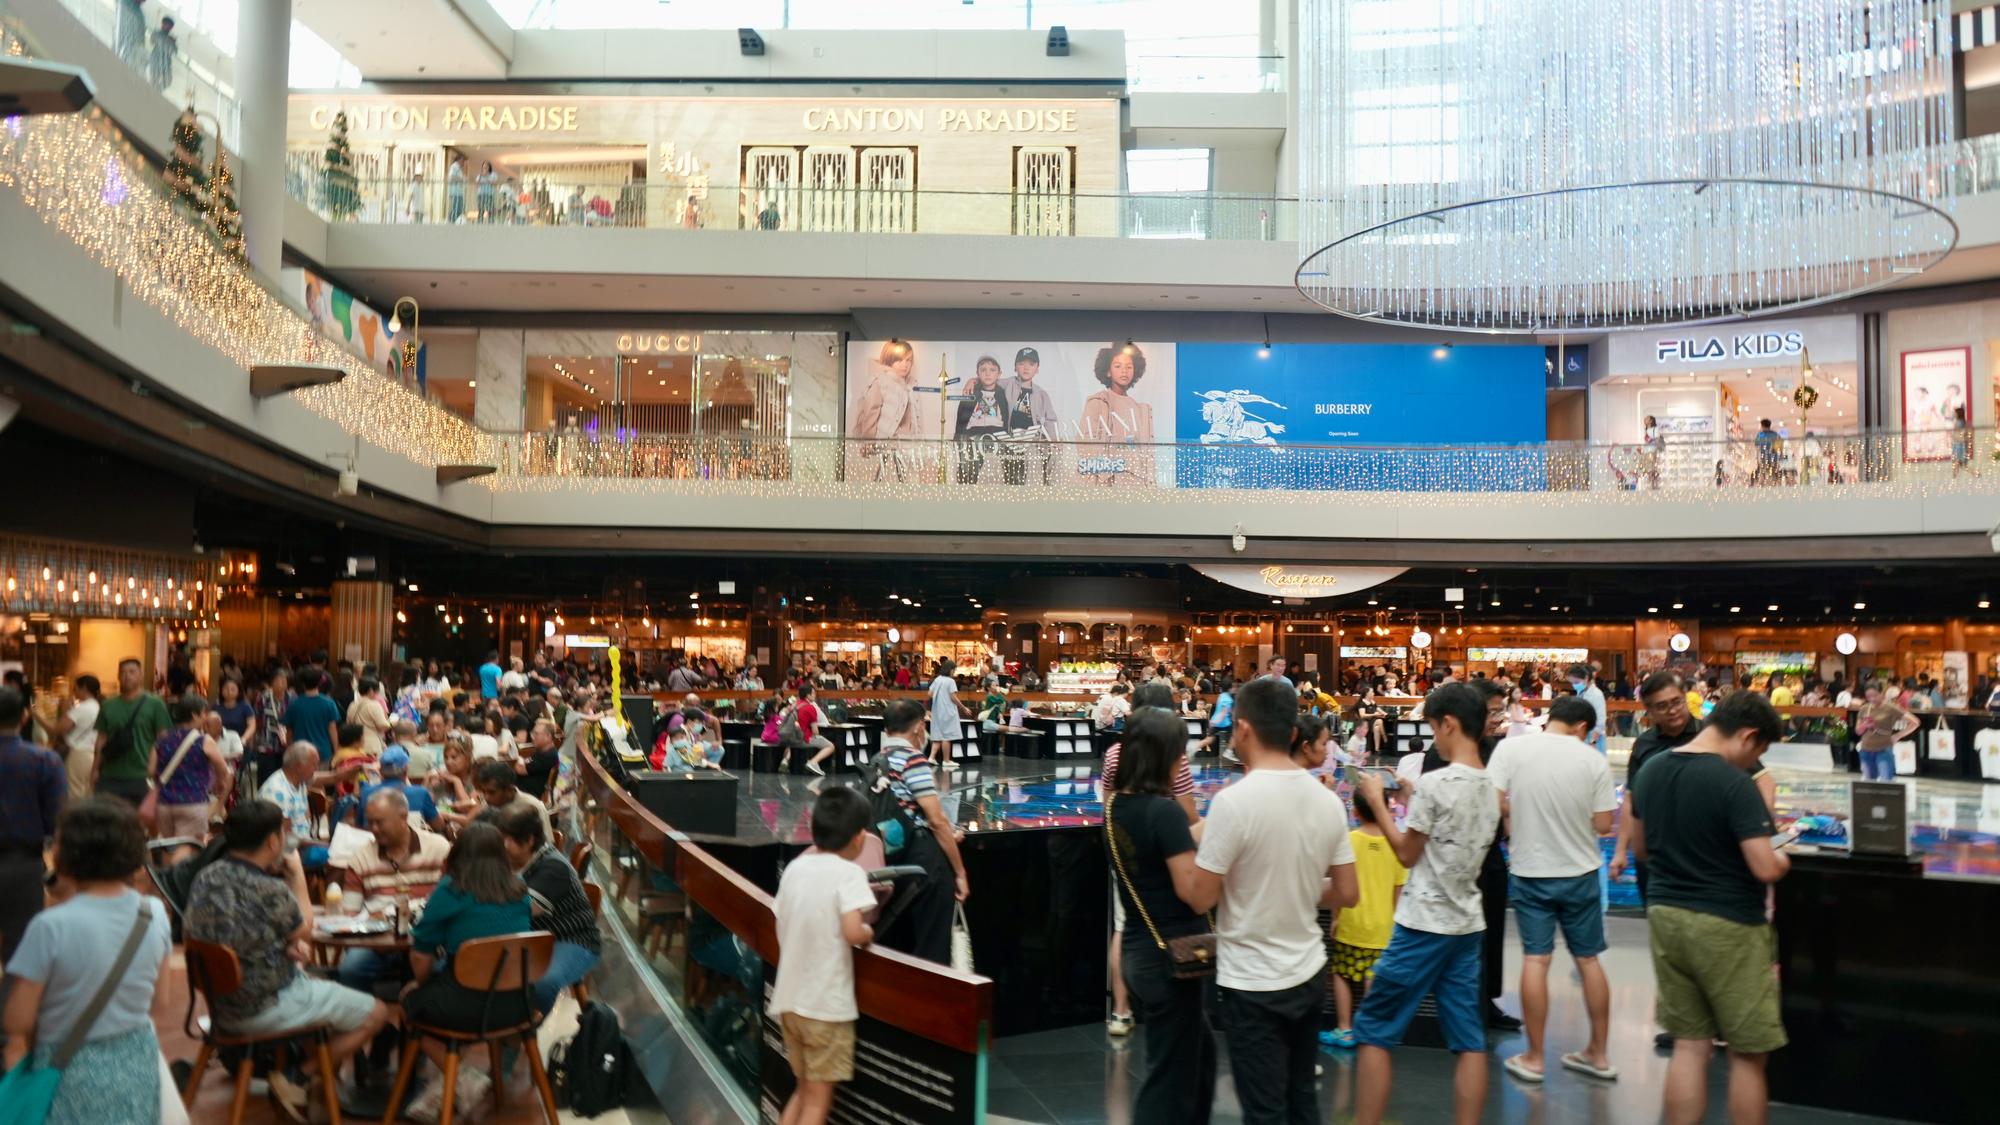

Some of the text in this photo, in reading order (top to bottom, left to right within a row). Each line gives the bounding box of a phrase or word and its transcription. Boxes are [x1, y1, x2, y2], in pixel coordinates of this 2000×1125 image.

[442, 106, 579, 131] PARADISE
[803, 108, 1077, 132] CANTON PARADISE
[616, 335, 701, 351] GUCCI
[1658, 332, 1802, 360] FILA KIDS
[1314, 404, 1372, 415] BURBERRY
[1038, 407, 1138, 442] ARMANI
[1260, 566, 1337, 588] Rasapura
